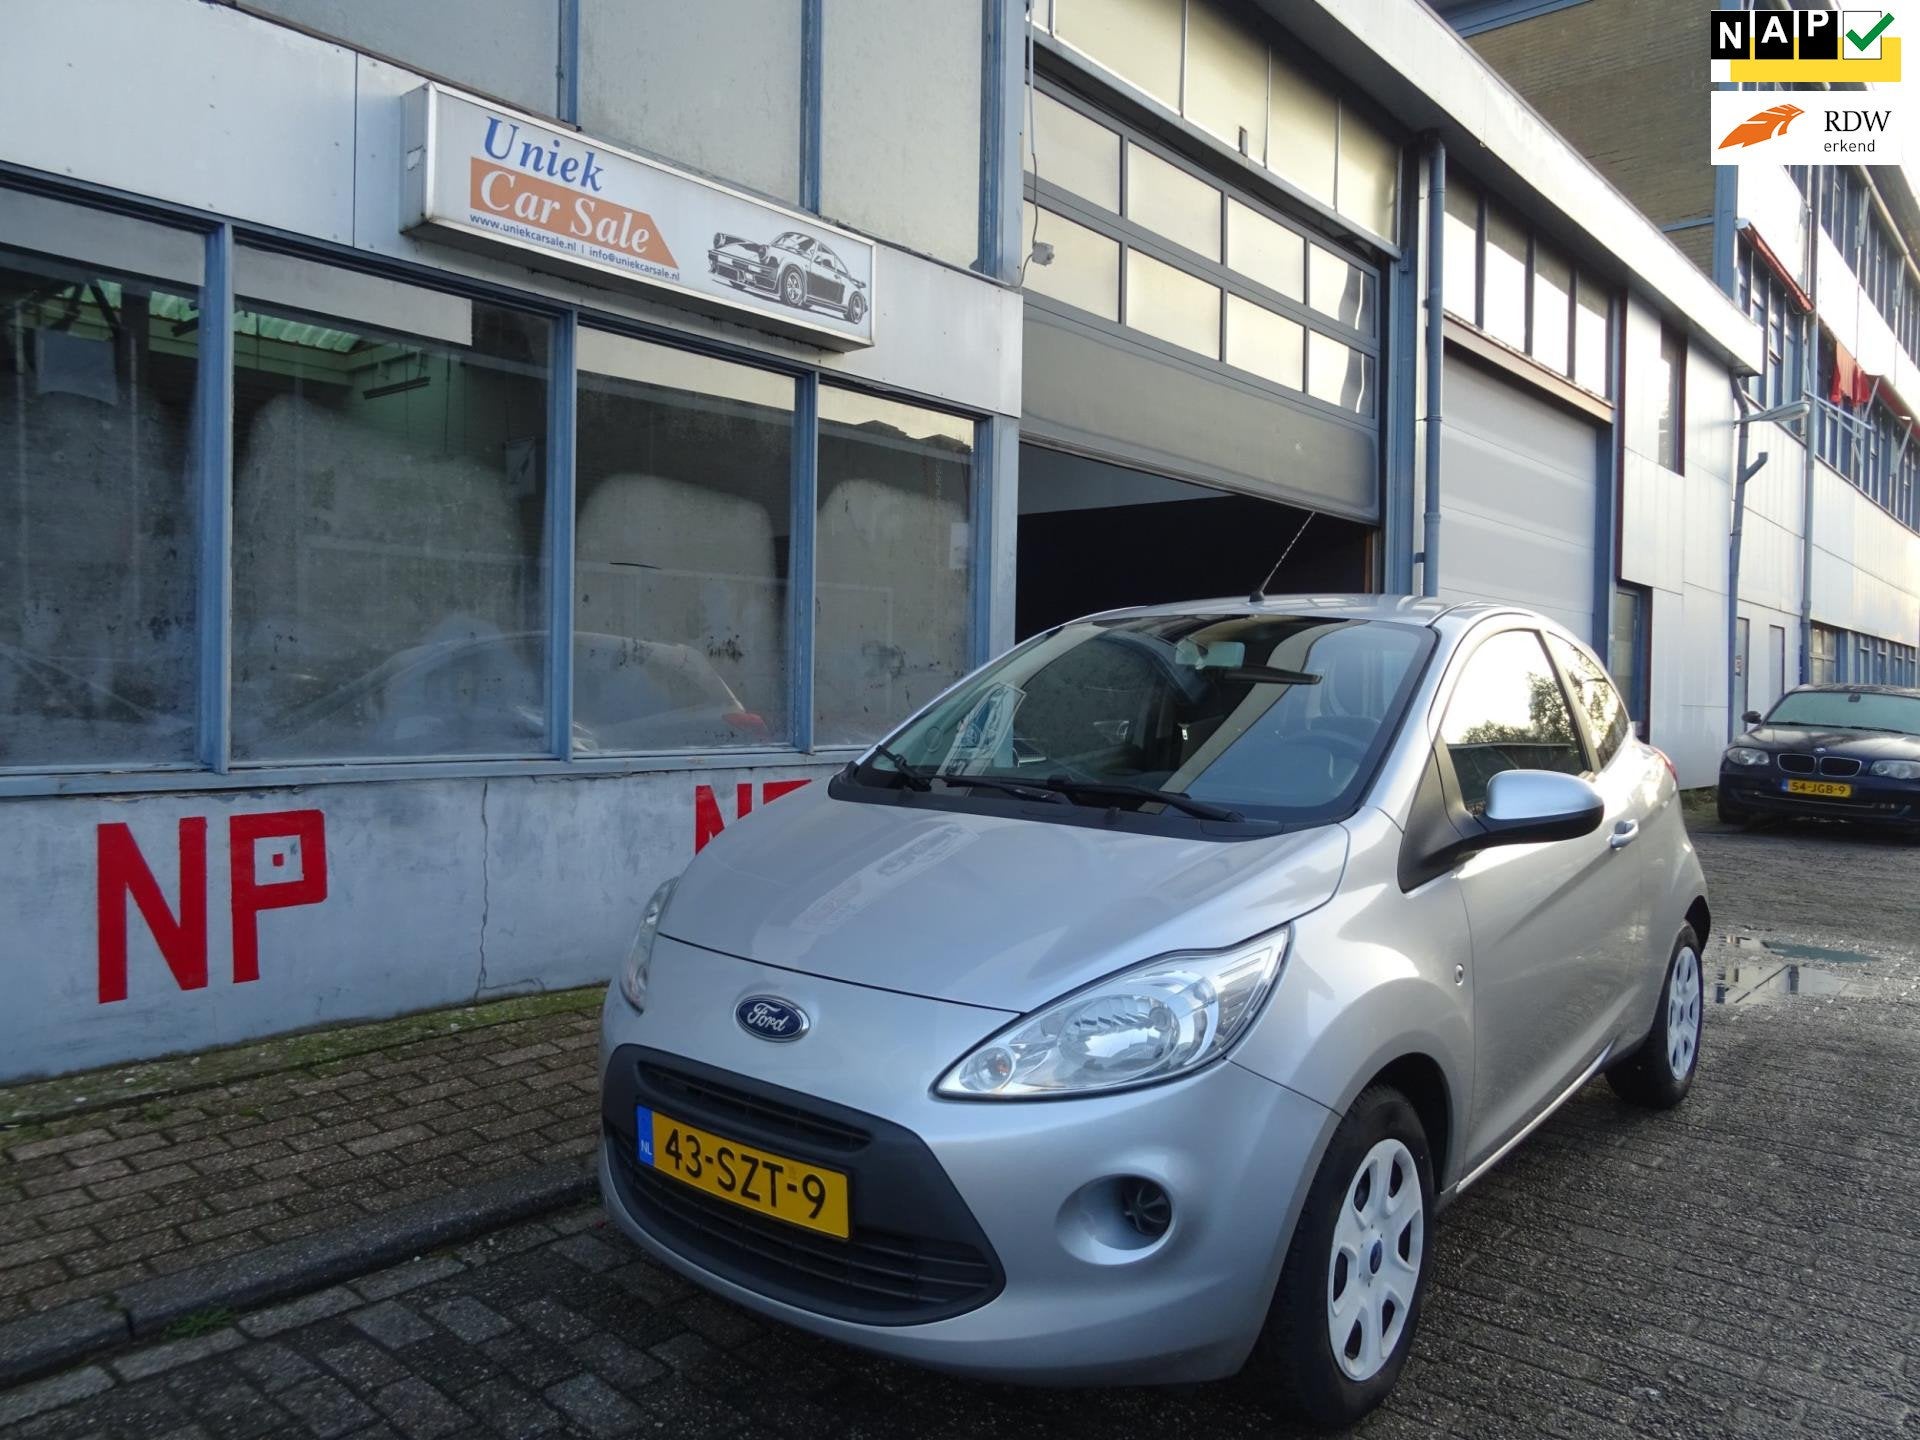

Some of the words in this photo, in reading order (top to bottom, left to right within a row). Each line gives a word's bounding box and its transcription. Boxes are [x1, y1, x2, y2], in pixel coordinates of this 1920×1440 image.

[484, 116, 604, 192] Uniek
[469, 213, 577, 252] www.uniekcarsale.nl
[589, 246, 680, 281] info@uniekcarsale.nl
[480, 170, 560, 224] Car
[569, 198, 650, 253] Sale
[1791, 781, 1846, 795] 54-JGB-9
[97, 809, 328, 1004] NP
[747, 1002, 788, 1032] Ford
[665, 1128, 826, 1219] 43-SZT-9
